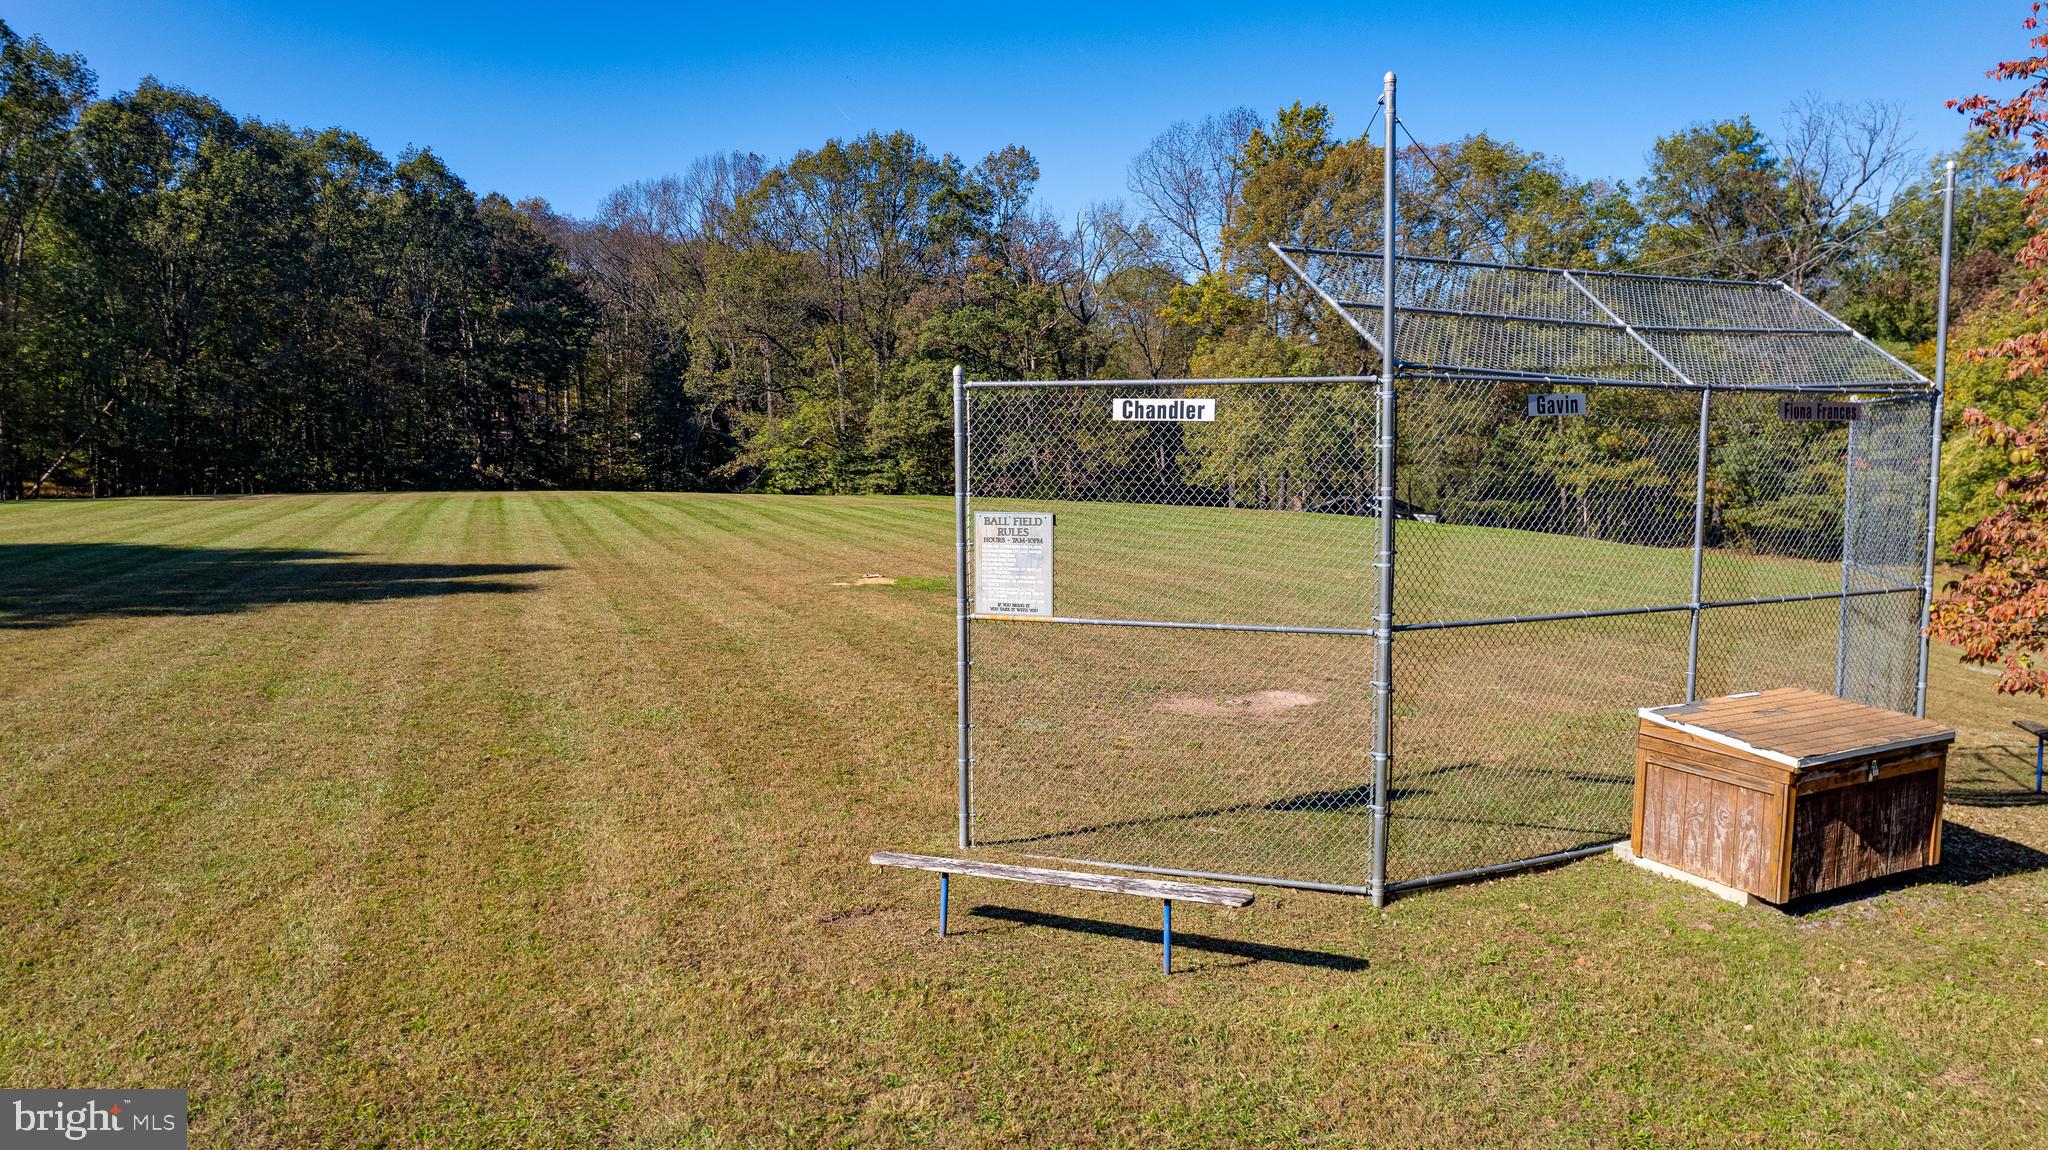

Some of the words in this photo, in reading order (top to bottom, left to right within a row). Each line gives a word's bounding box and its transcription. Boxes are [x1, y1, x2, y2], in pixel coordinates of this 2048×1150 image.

[1122, 400, 1205, 419] Chandler
[1536, 395, 1578, 414] Gavin
[1784, 404, 1812, 419] Fiona
[1817, 404, 1857, 419] Frances
[984, 516, 1010, 526] BALL
[1013, 517, 1043, 527] FIELD
[997, 528, 1030, 537] RULES
